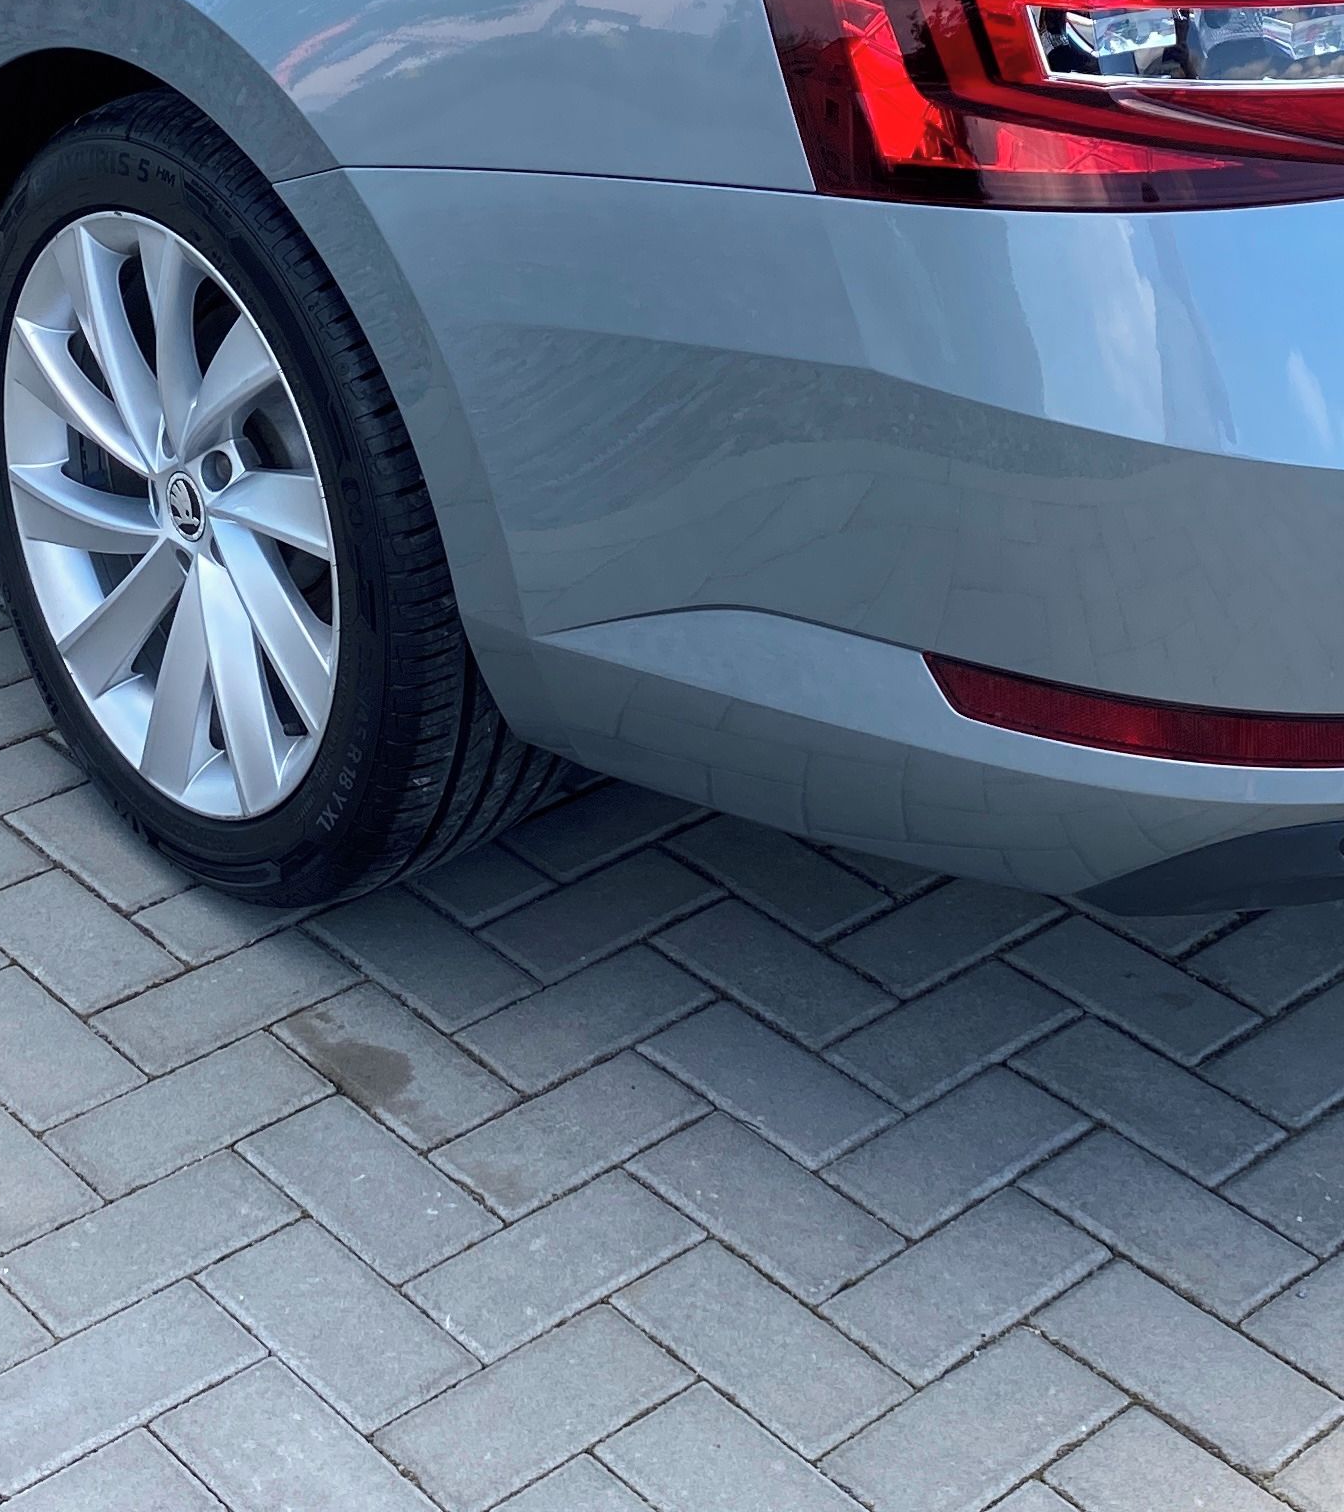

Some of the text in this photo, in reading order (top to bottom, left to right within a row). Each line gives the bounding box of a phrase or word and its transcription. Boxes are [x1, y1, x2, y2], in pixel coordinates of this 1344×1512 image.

[137, 158, 151, 184] 5
[156, 164, 176, 188] HM
[338, 765, 356, 789] 18
[316, 802, 340, 831] XL
